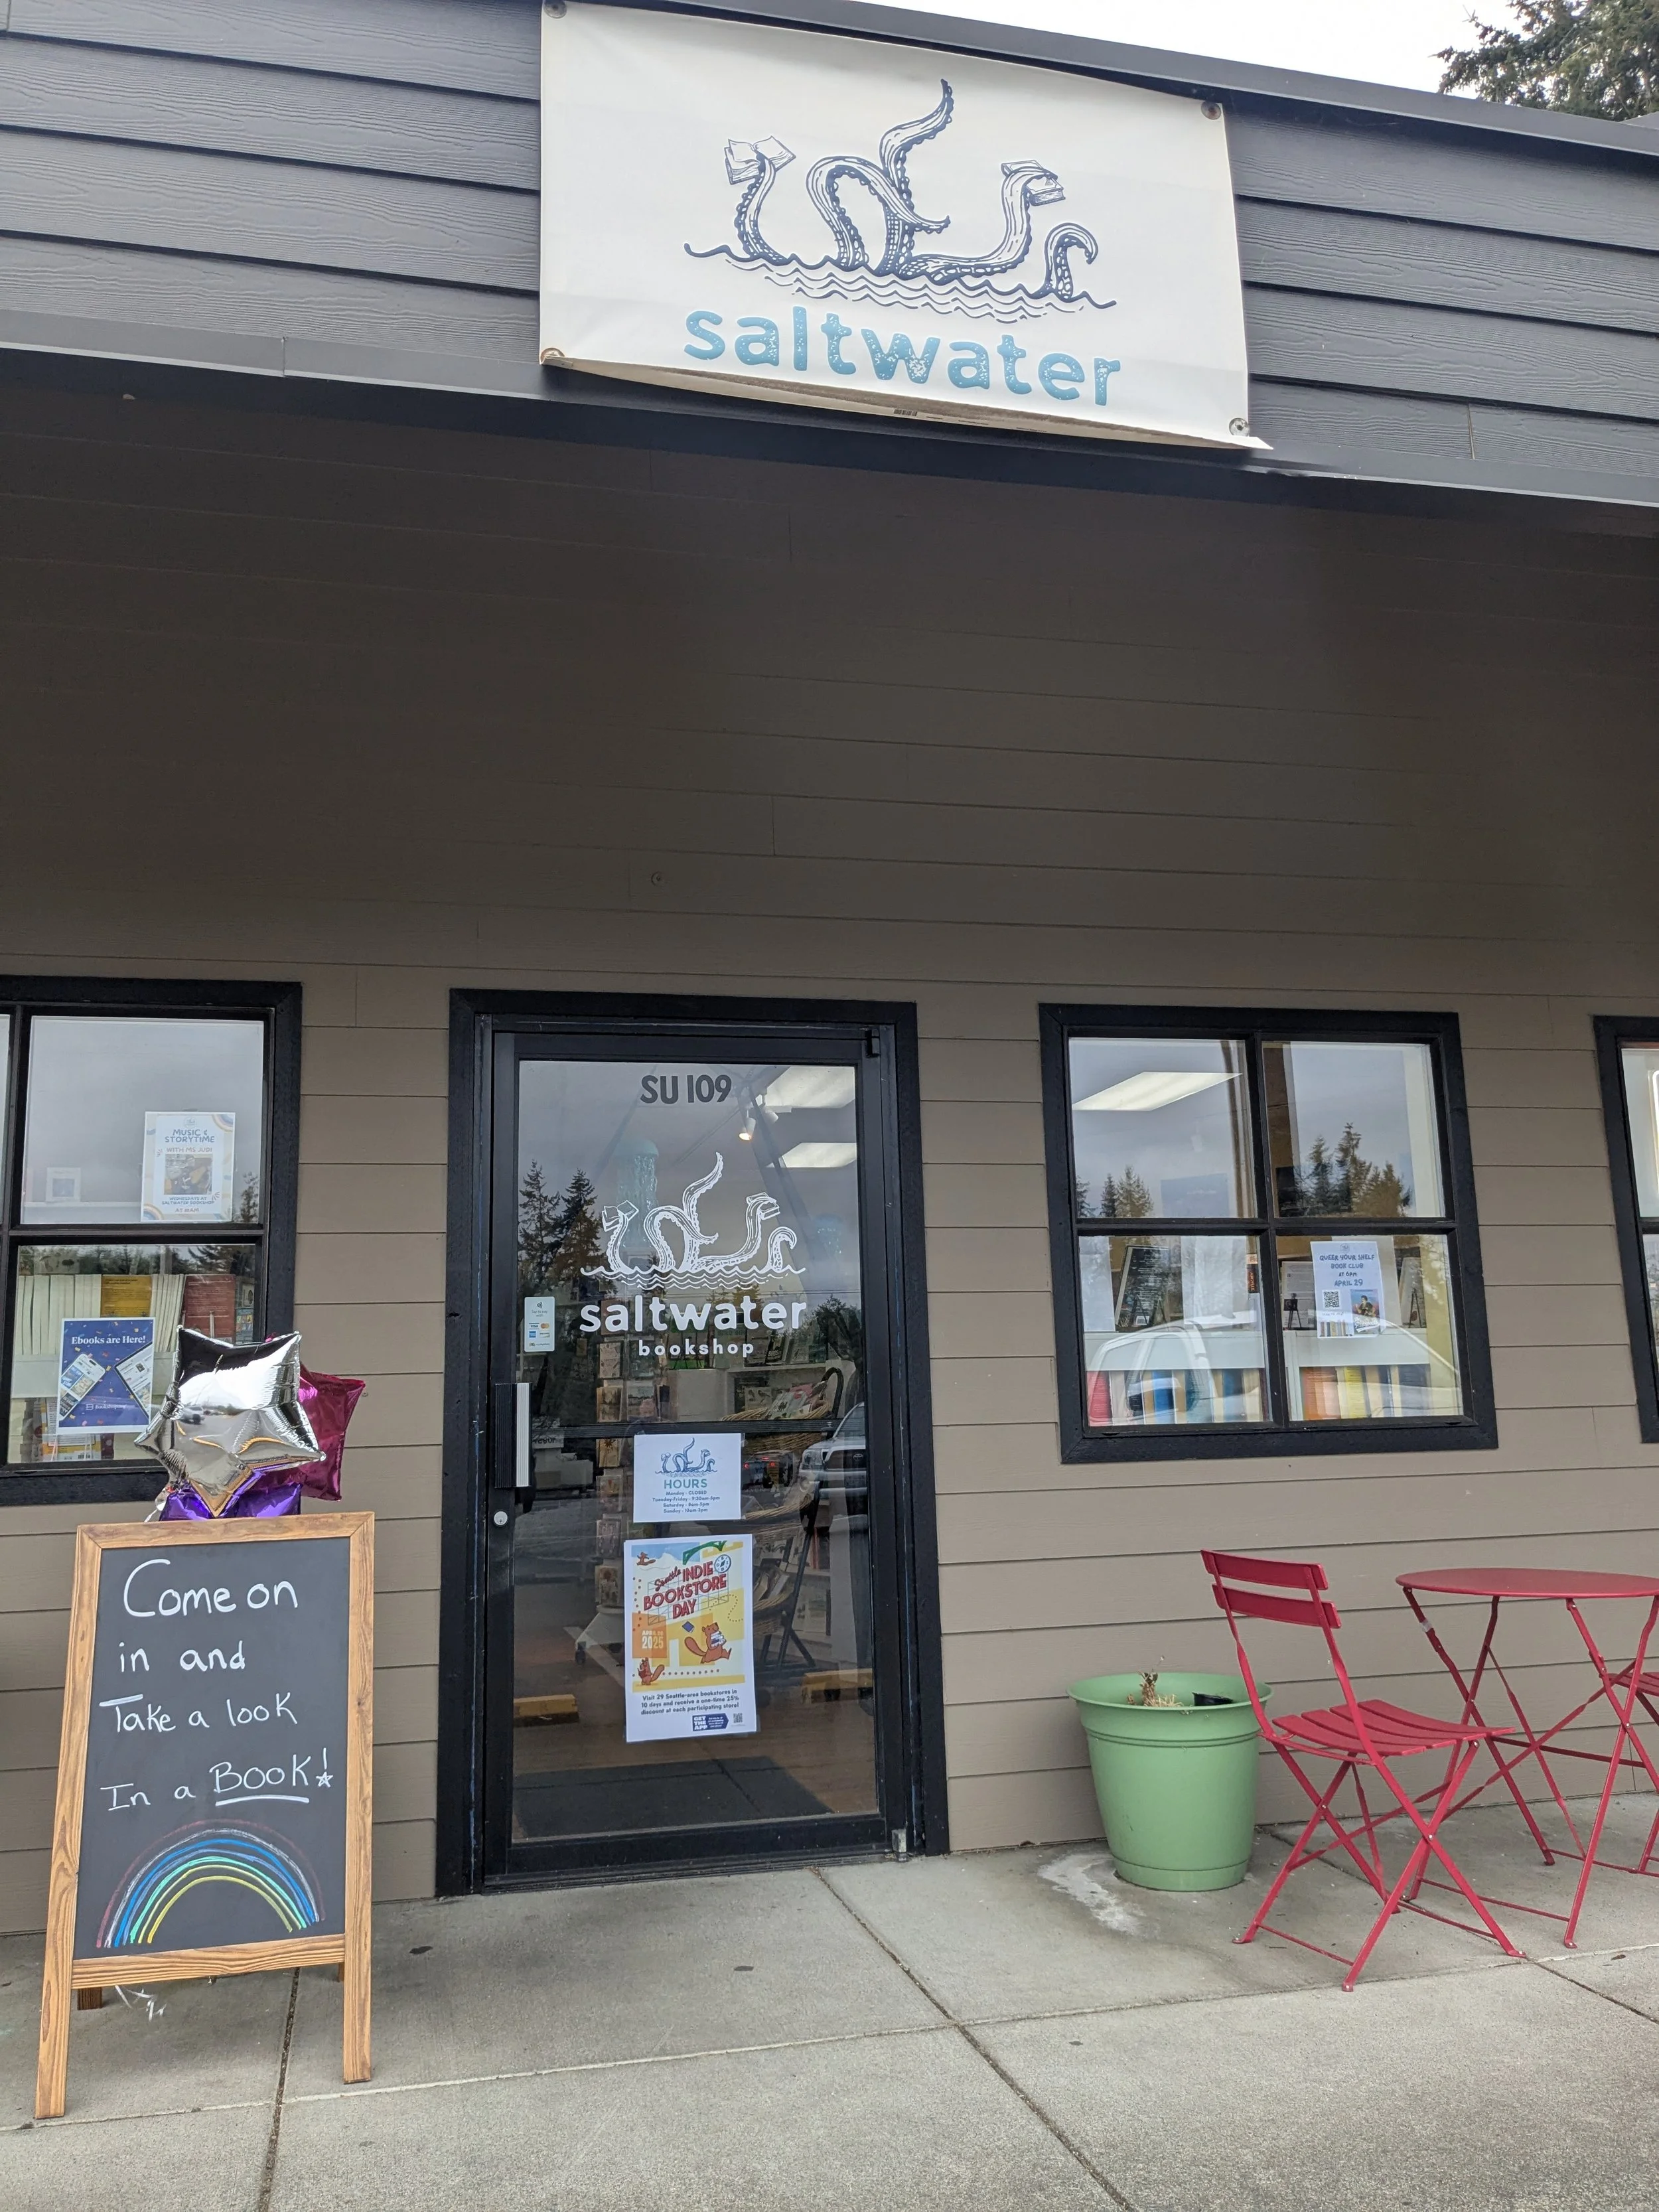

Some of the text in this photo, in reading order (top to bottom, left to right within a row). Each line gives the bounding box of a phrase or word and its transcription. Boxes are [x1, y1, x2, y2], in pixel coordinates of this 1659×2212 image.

[684, 305, 1120, 406] saltwater
[640, 1074, 731, 1104] SU 109
[579, 1295, 807, 1333] saltwater
[122, 1335, 146, 1344] Here!
[638, 1339, 754, 1358] bookshop
[664, 1479, 708, 1489] HOURS
[123, 1558, 299, 1617] Come on
[654, 1560, 713, 1591] Seattle INDIE
[643, 1574, 727, 1611] BOOKSTORE
[672, 1599, 697, 1619] DAY
[118, 1640, 246, 1672] in and
[642, 1636, 664, 1649] 2025
[99, 1694, 176, 1733] Take
[188, 1710, 210, 1729] a
[687, 1704, 722, 1712] participating
[100, 1783, 151, 1811] In
[175, 1785, 196, 1800] a
